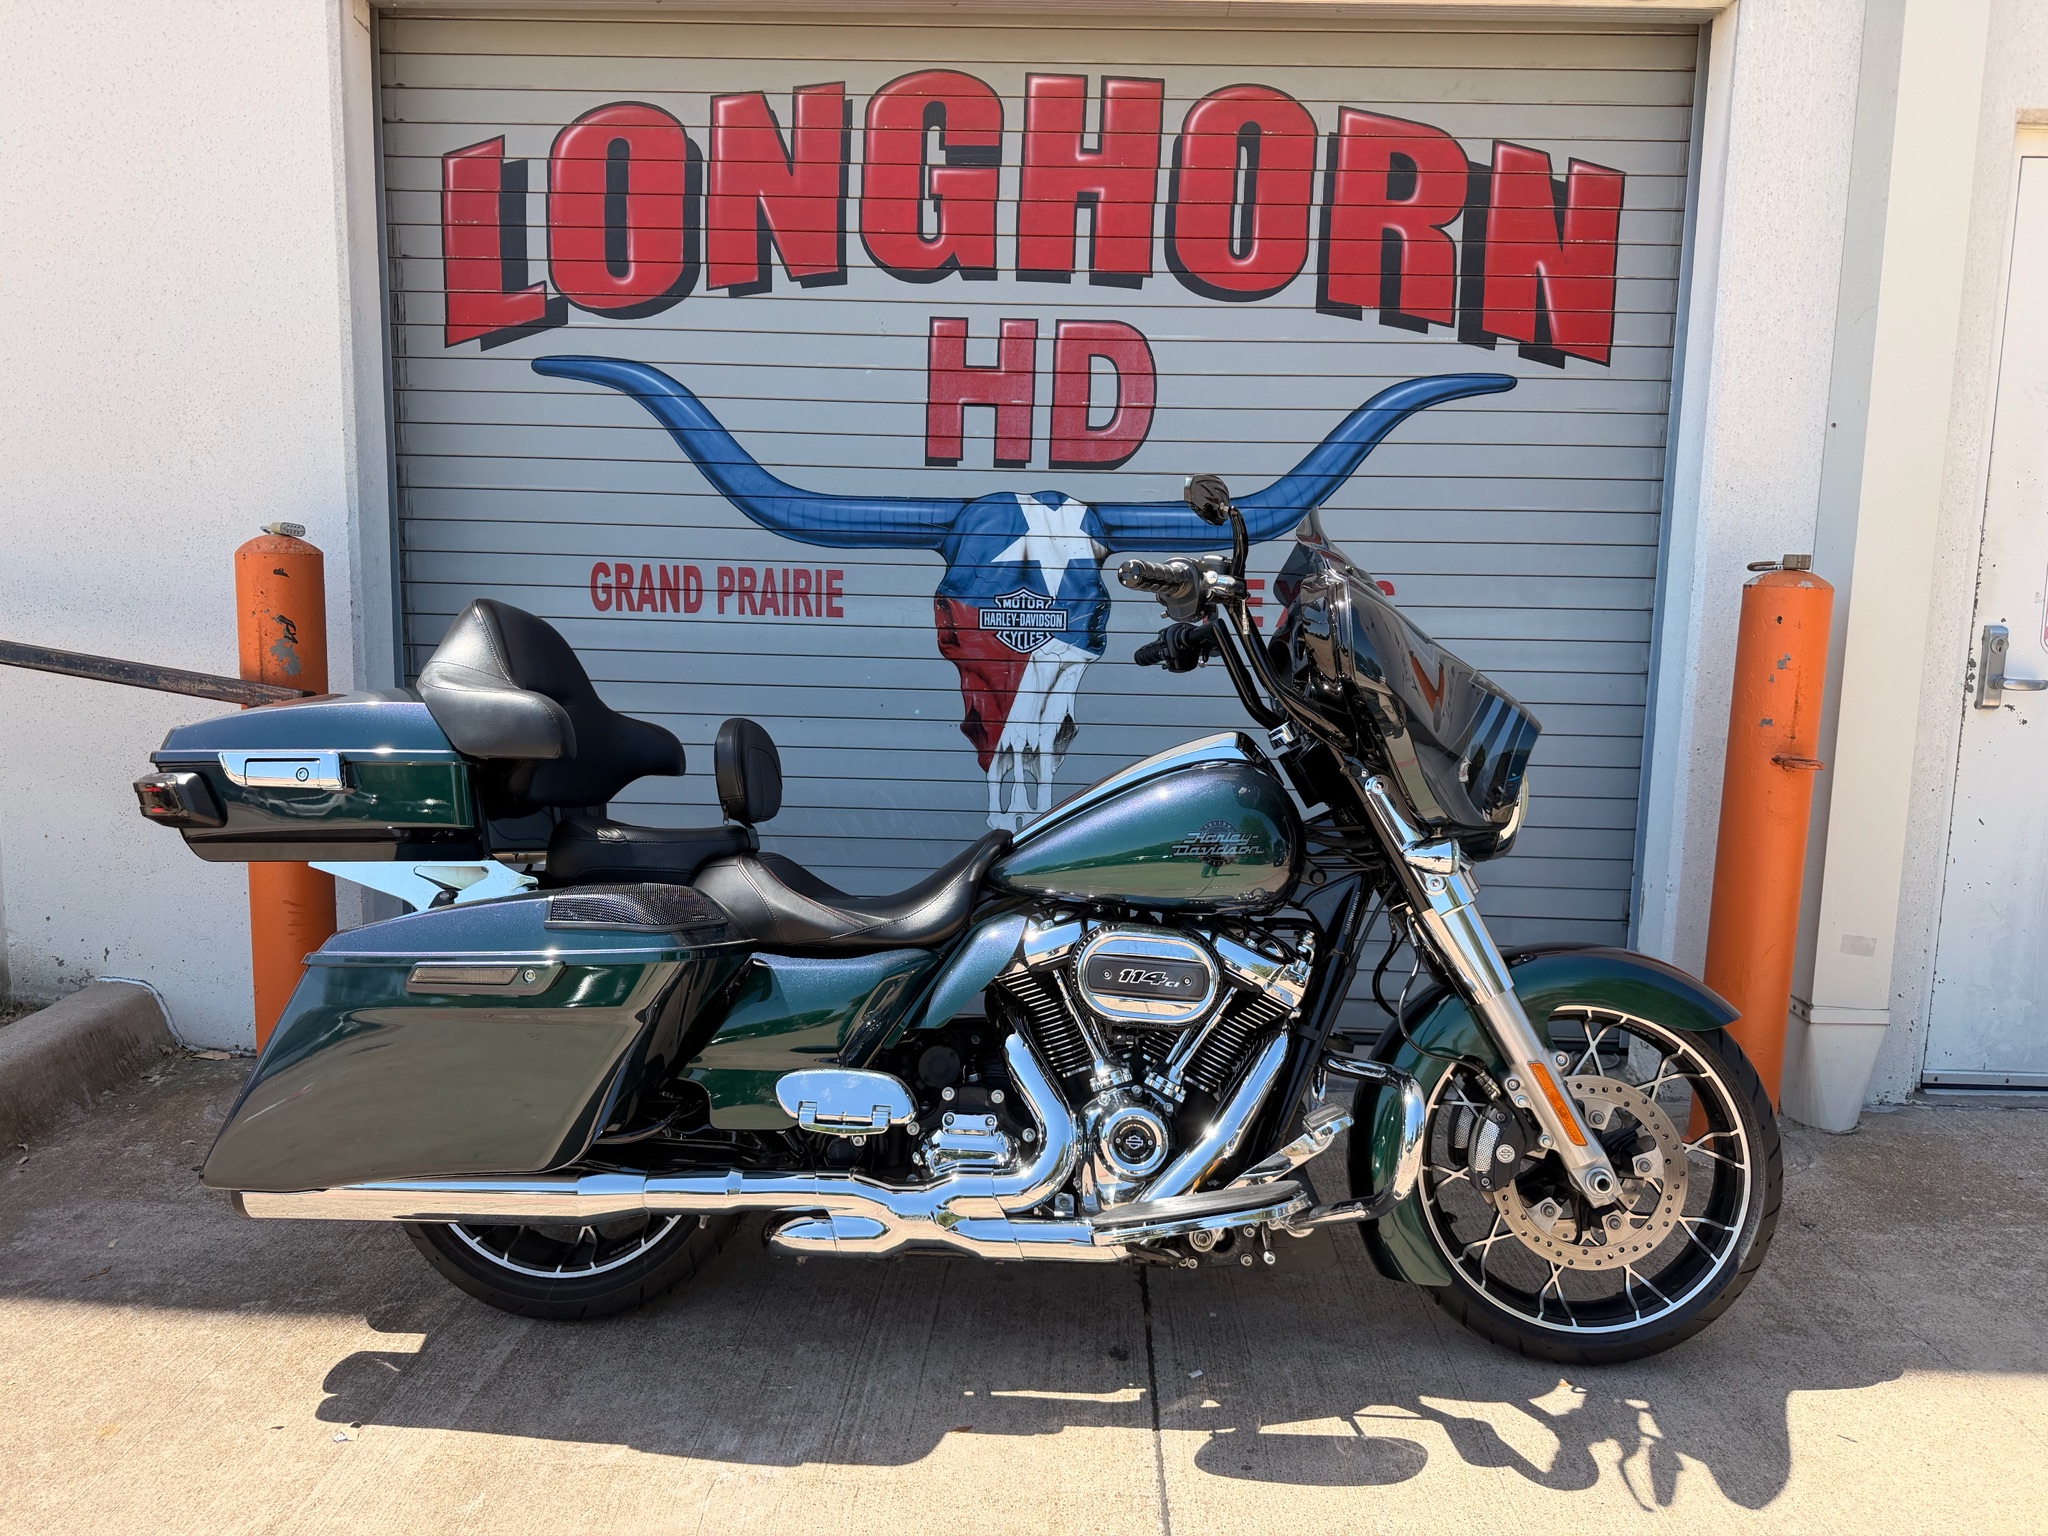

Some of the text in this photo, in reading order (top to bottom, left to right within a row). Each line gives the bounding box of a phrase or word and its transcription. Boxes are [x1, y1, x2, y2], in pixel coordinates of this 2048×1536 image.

[441, 69, 1626, 367] LONGHORN
[925, 317, 1158, 469] HD
[590, 561, 844, 618] GRAND PRAIRIE
[1002, 593, 1045, 609] MOTOR
[983, 611, 1063, 628] HARLEY-DAVIDSON
[1002, 630, 1045, 650] CYCLES
[1171, 844, 1265, 856] Davidson
